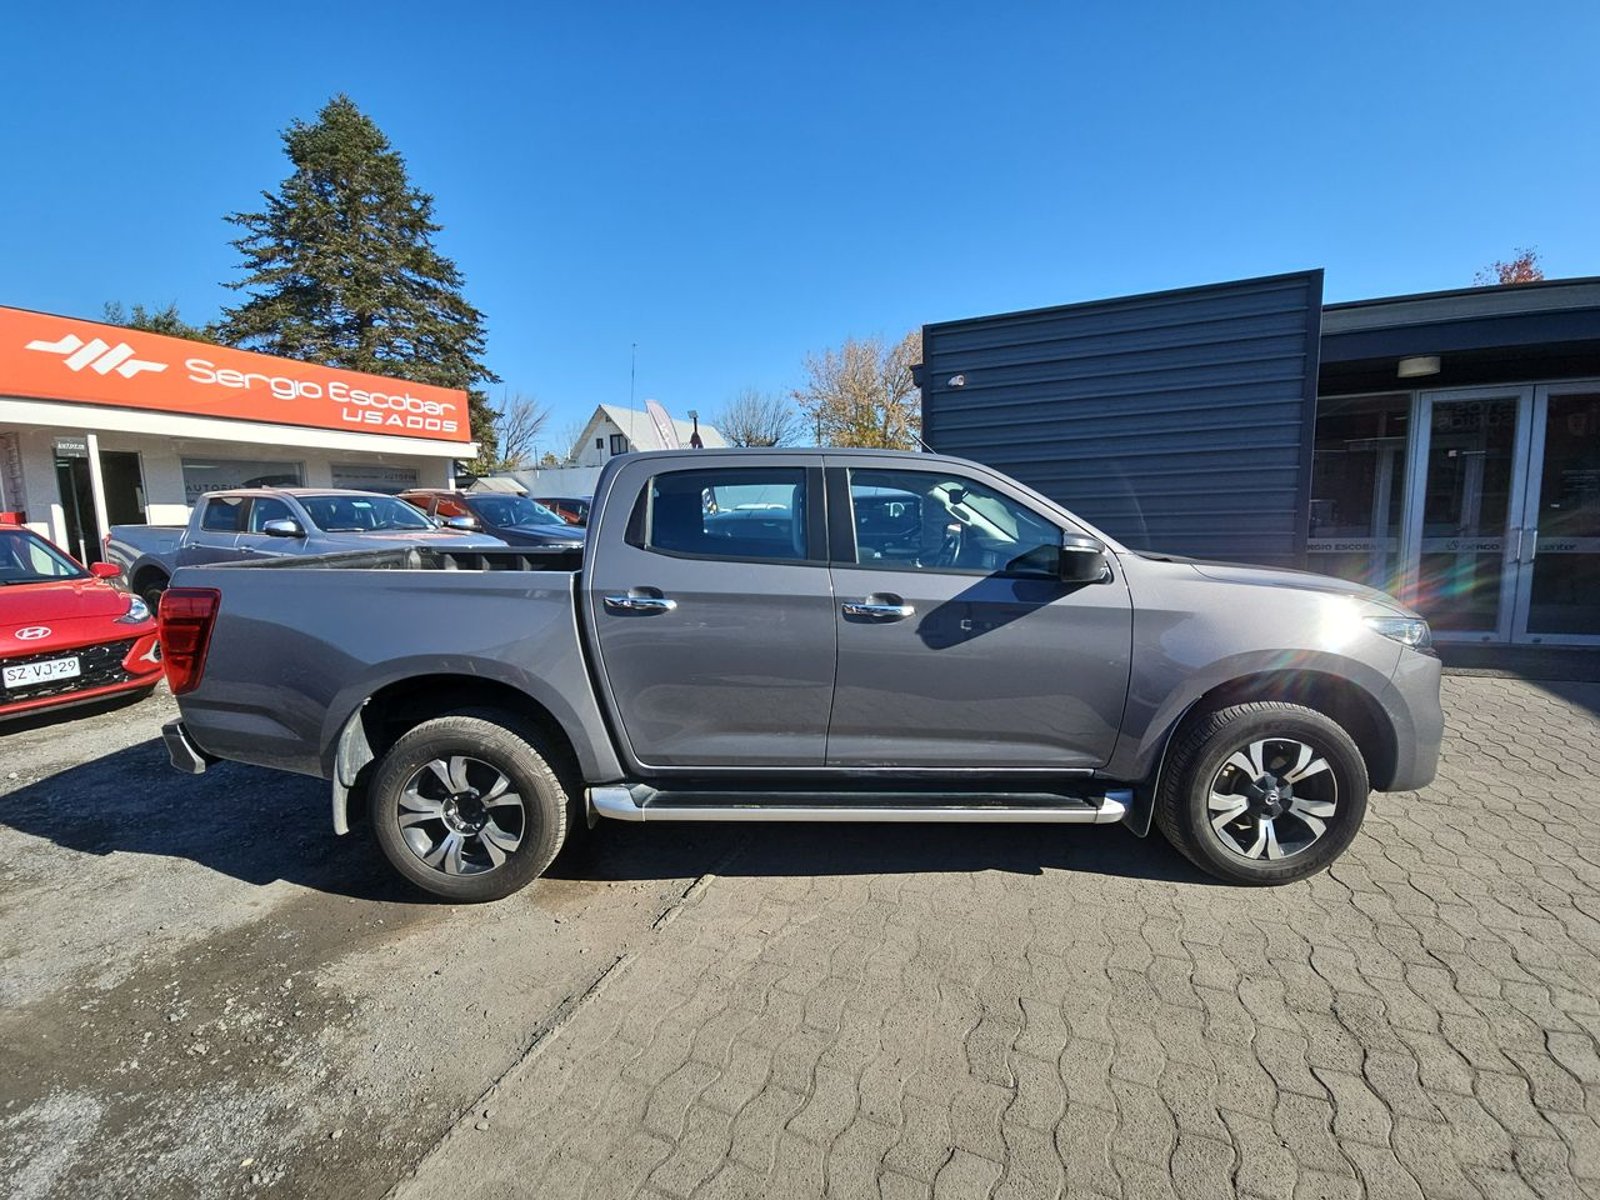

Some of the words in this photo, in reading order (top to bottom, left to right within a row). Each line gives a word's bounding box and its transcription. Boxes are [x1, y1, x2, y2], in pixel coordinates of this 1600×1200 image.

[185, 358, 323, 400] Sergio
[328, 381, 457, 416] Escobar
[342, 407, 458, 433] USADOS
